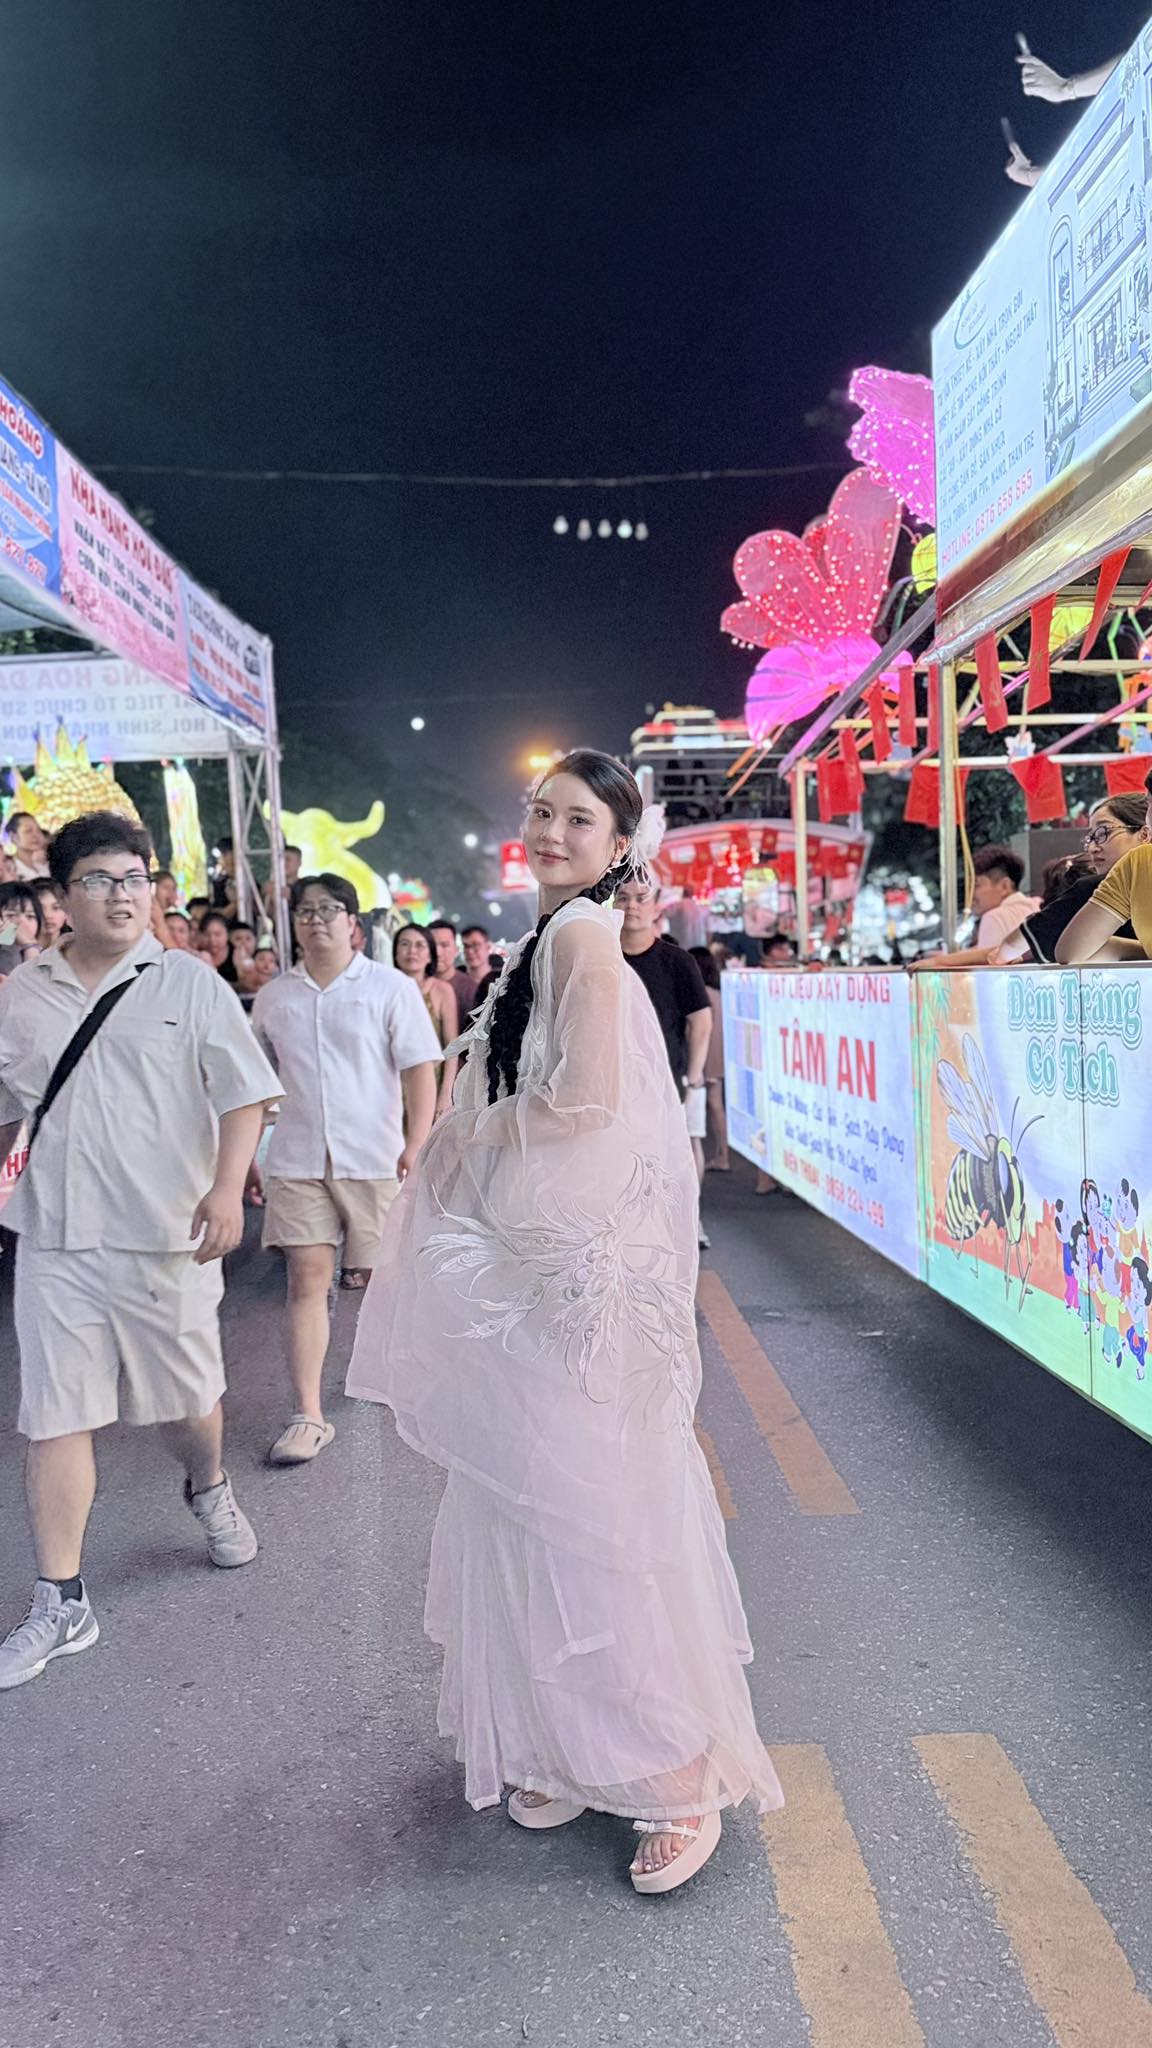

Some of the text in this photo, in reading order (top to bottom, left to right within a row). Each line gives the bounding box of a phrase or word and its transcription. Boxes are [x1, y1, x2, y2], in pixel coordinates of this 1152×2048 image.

[1005, 320, 1021, 353] NGOẠI
[1023, 296, 1037, 330] THẤT
[1008, 442, 1022, 468] THAN
[1023, 430, 1033, 454] TRE
[942, 524, 974, 565] HOTLINE:
[1008, 971, 1142, 1049] Đêm Trăng
[779, 1017, 877, 1103] TÂM AN
[1026, 1034, 1119, 1106] Cổ Tích
